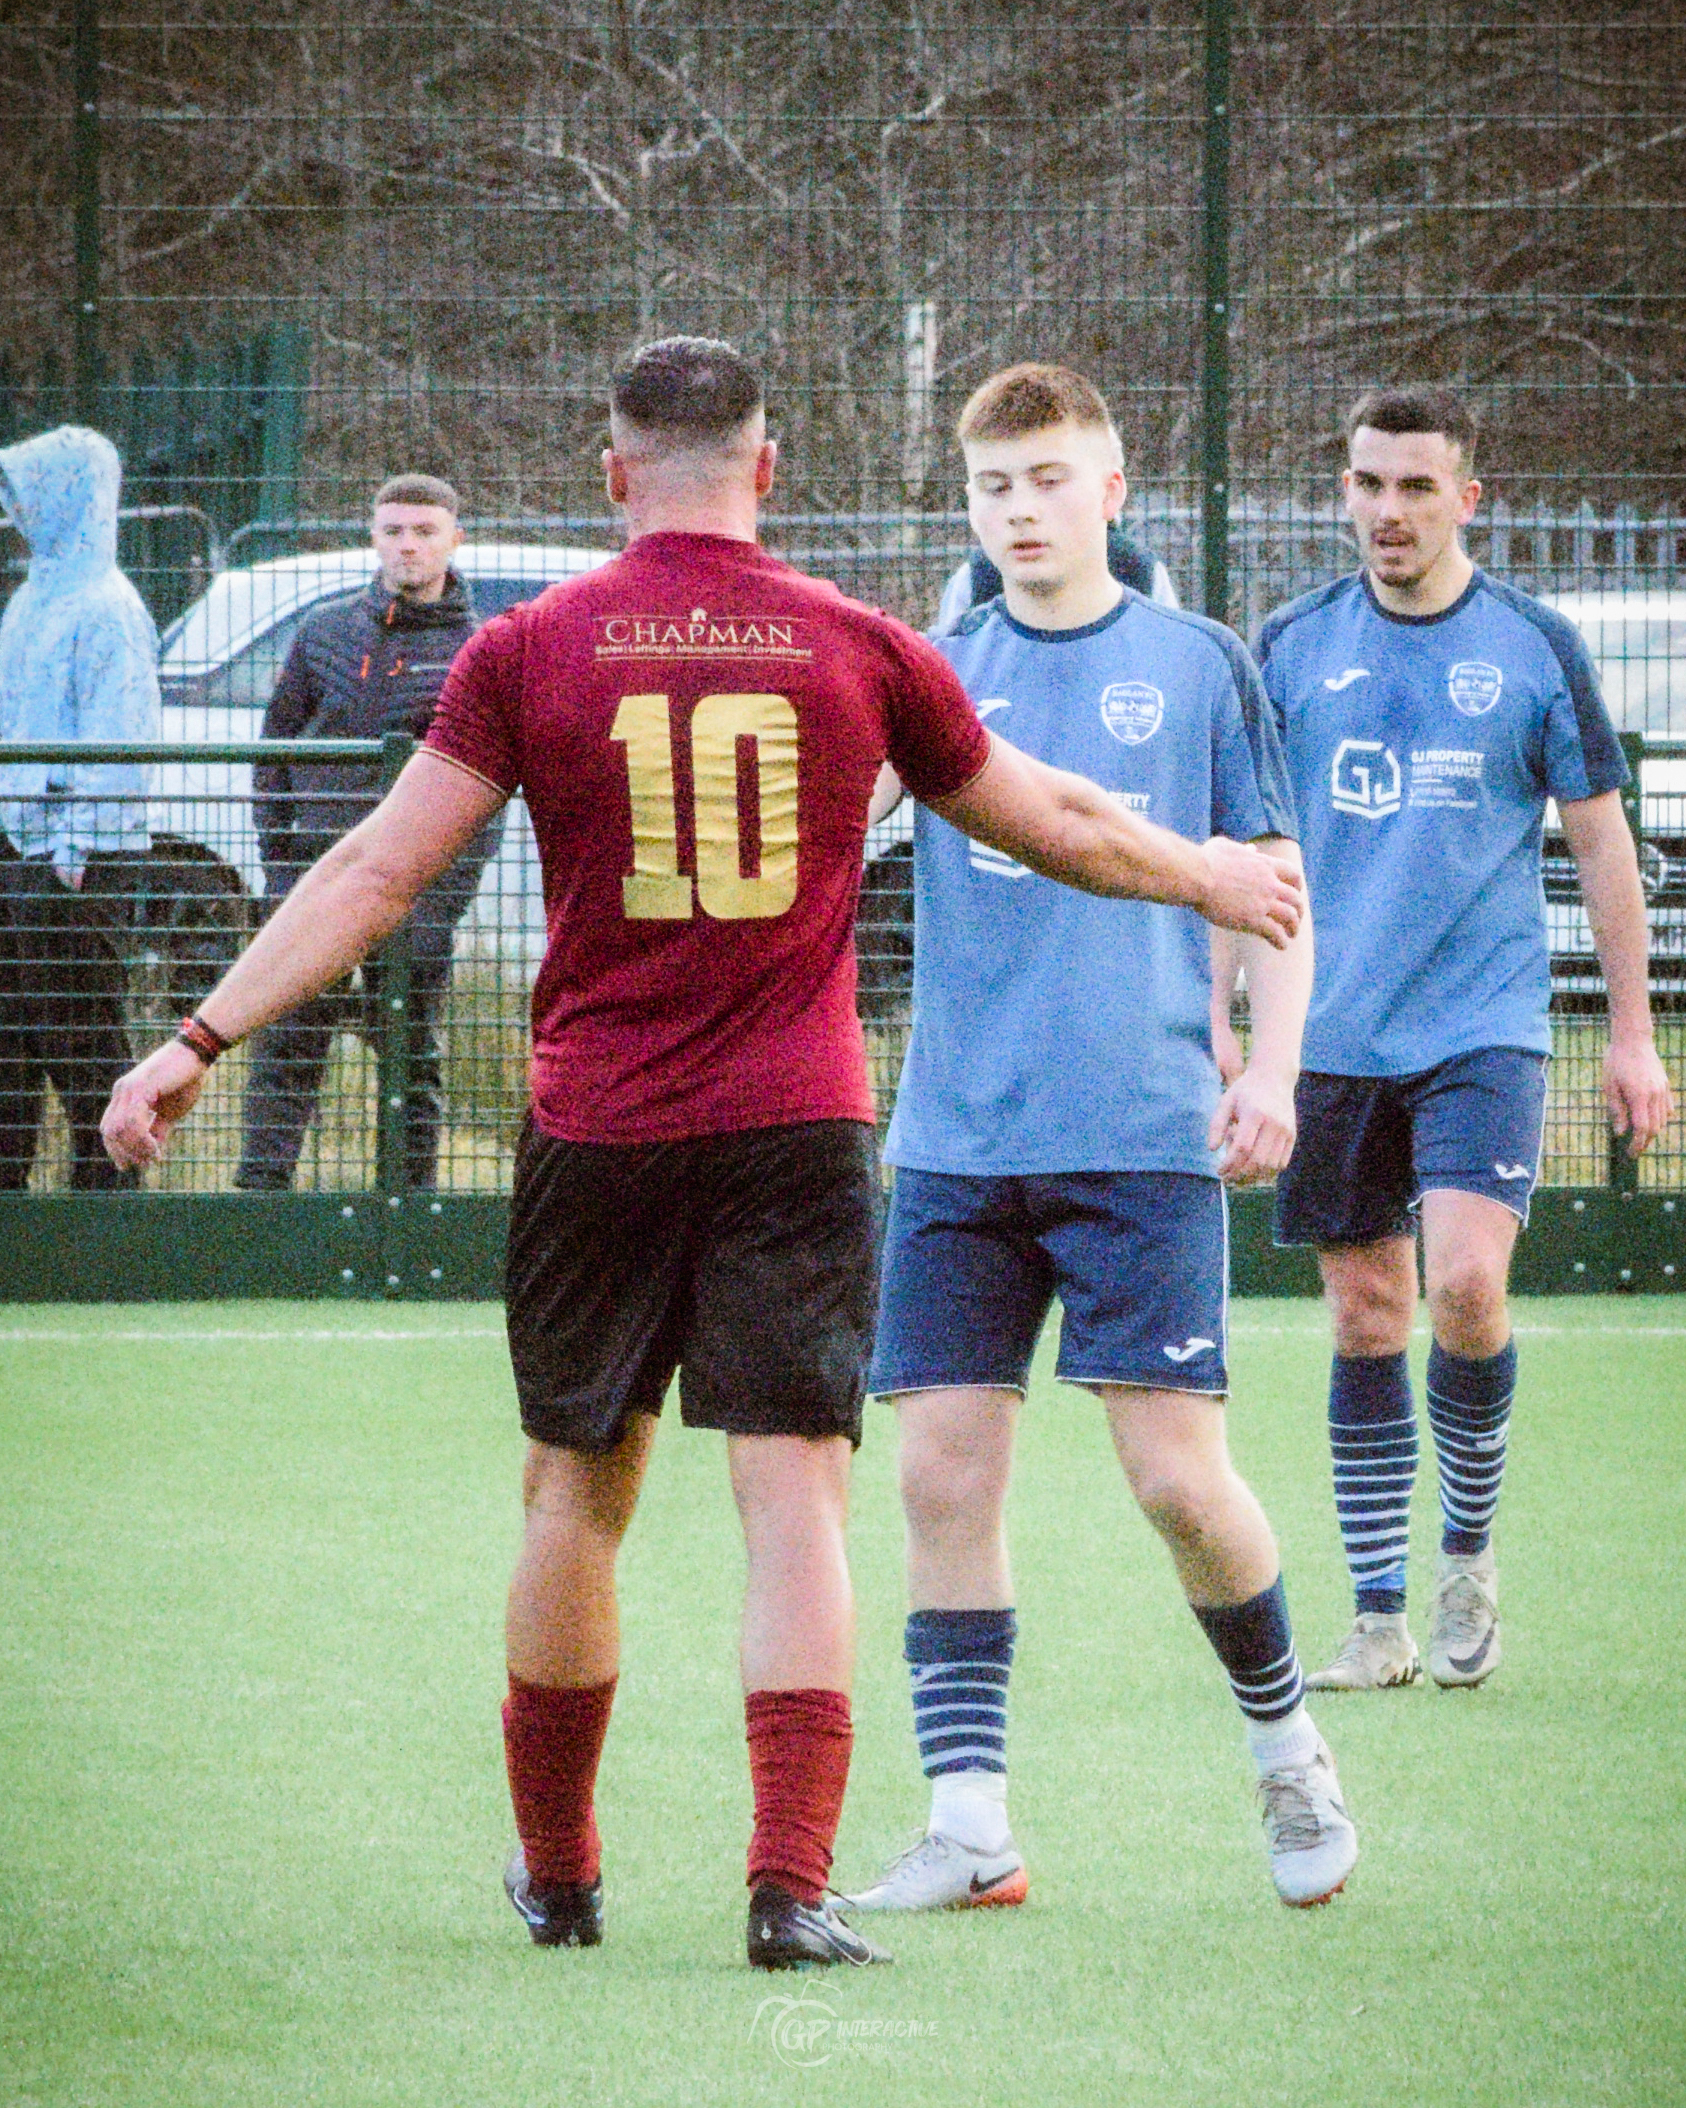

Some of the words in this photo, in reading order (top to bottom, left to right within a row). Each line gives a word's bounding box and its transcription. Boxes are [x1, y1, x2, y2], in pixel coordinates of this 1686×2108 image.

[605, 620, 792, 644] CHAPMAN
[1426, 750, 1484, 765] PROPERTY
[609, 693, 798, 919] 10
